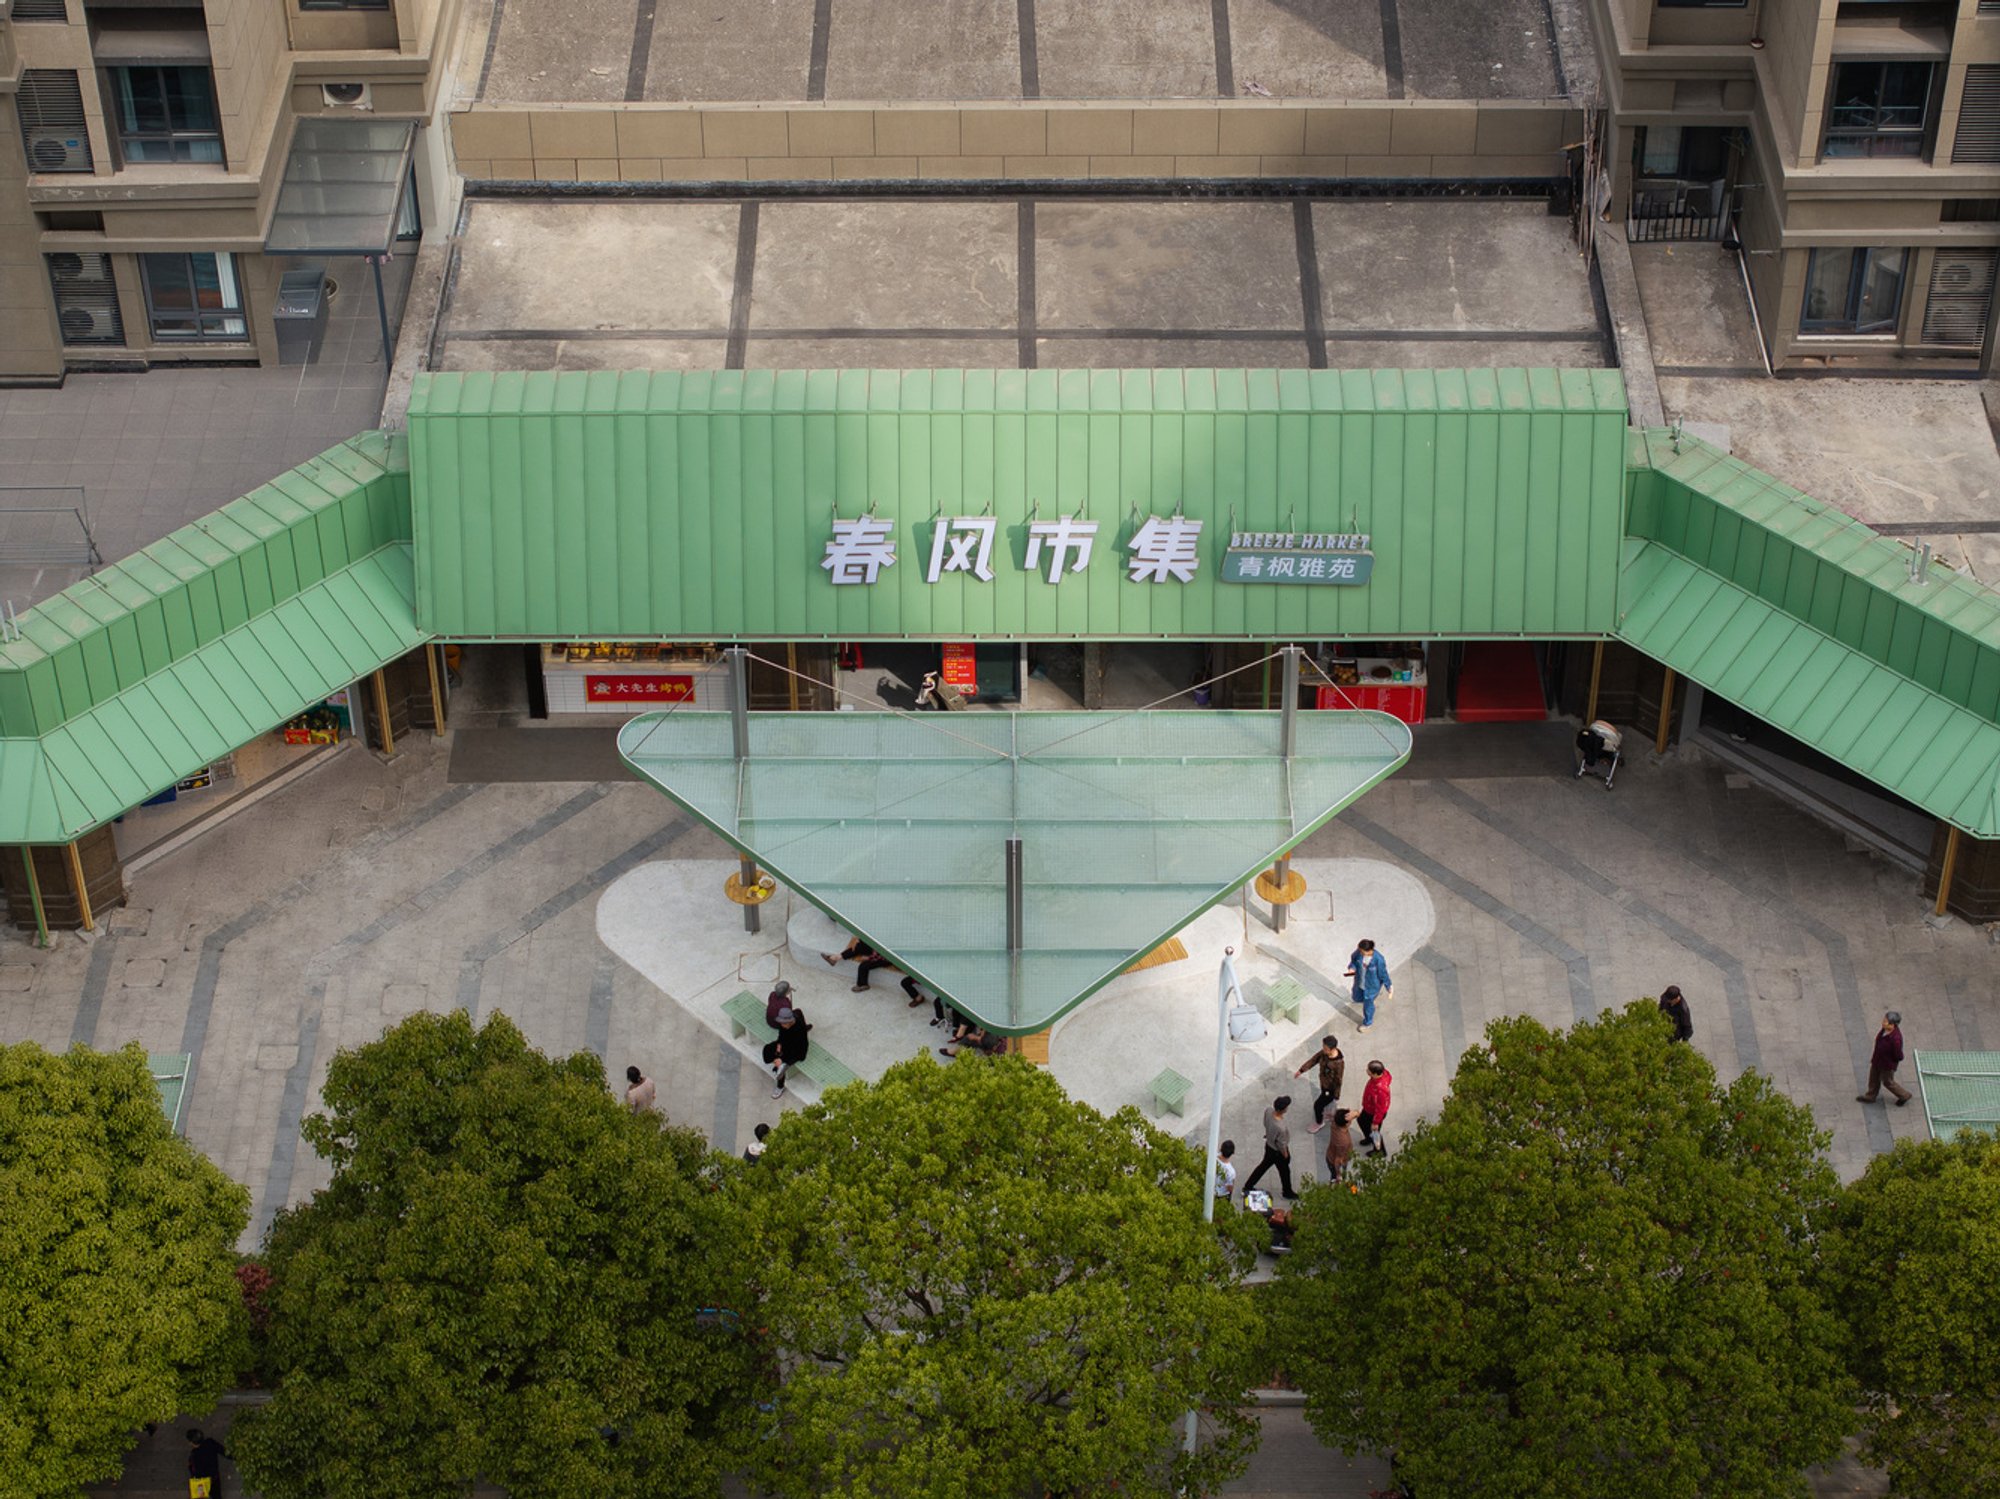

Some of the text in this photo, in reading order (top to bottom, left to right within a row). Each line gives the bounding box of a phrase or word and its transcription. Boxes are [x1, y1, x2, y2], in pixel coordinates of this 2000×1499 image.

[820, 513, 1203, 585] 春风市集
[1231, 533, 1370, 550] BREEZE MARKET
[1238, 556, 1356, 579] 青枫雅苑
